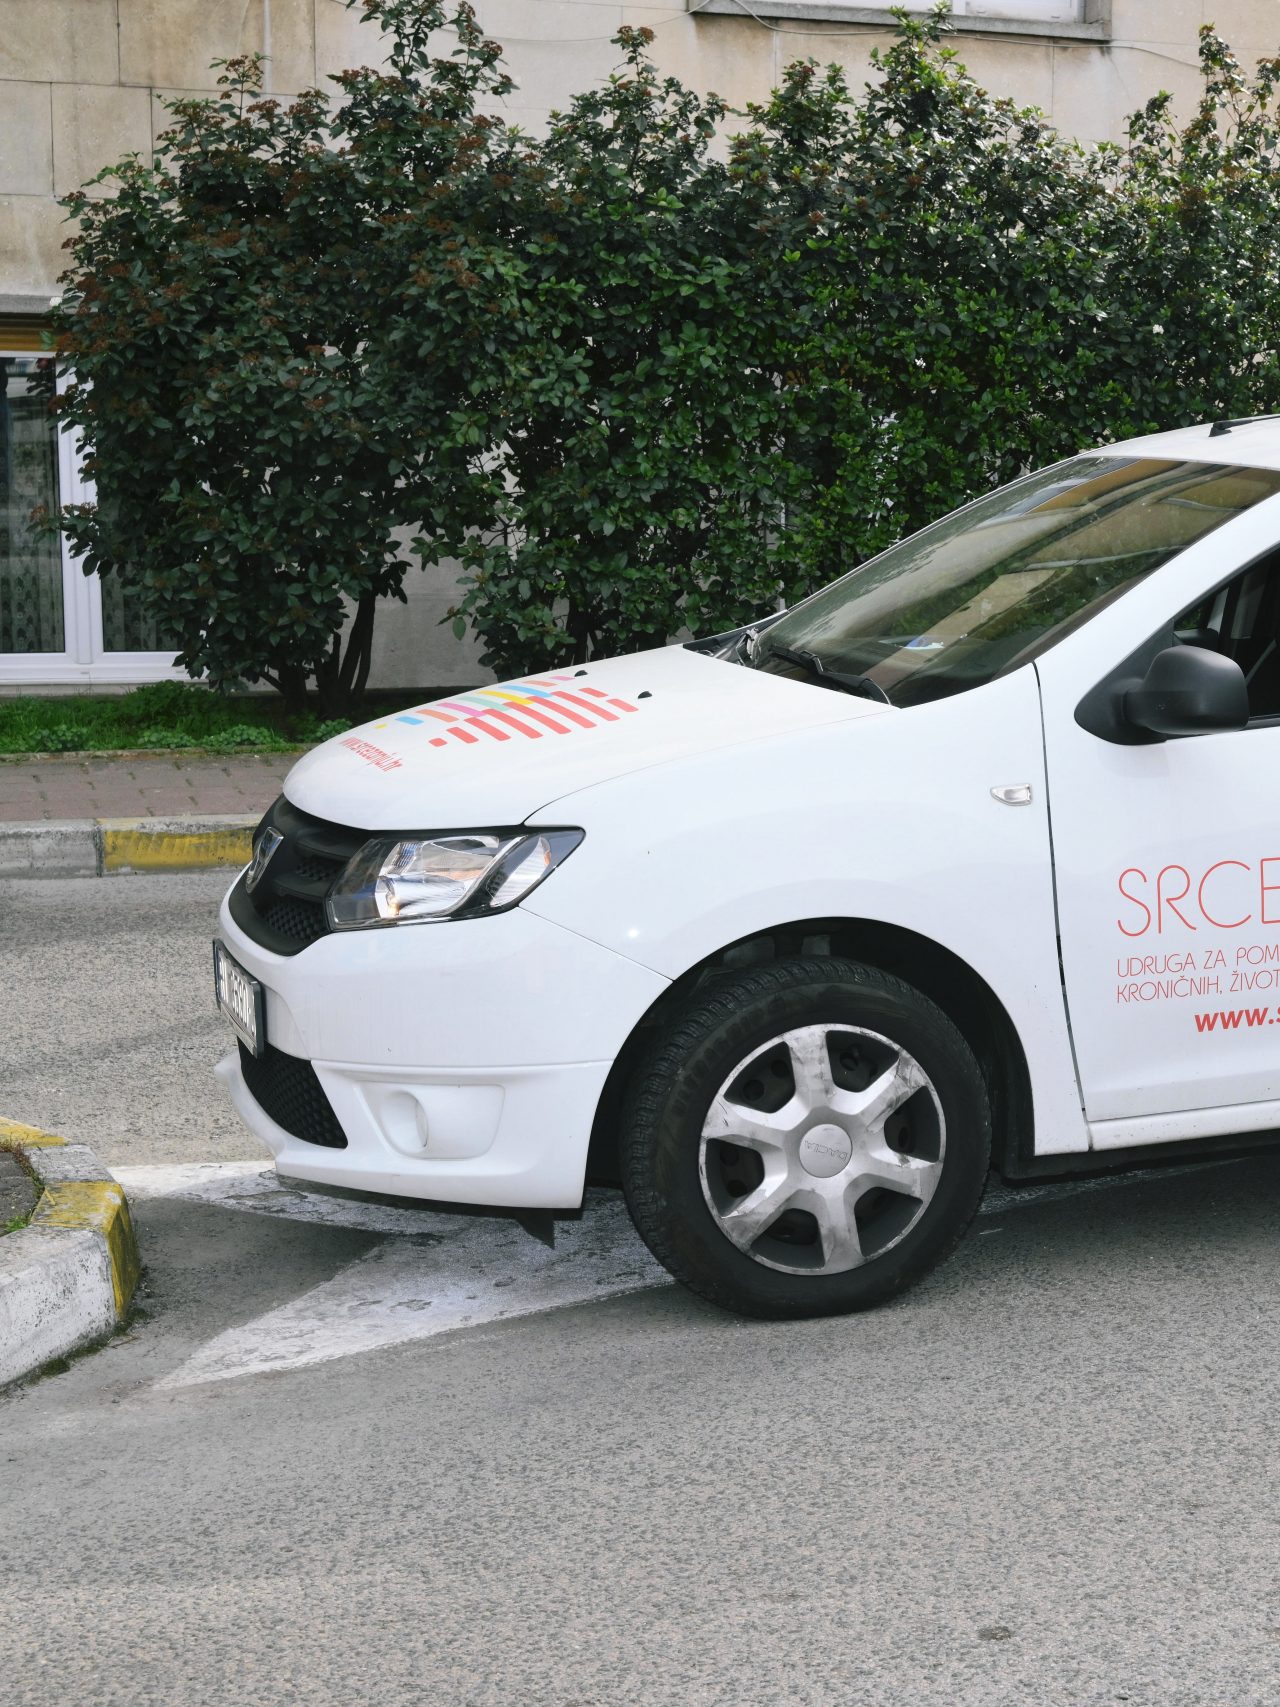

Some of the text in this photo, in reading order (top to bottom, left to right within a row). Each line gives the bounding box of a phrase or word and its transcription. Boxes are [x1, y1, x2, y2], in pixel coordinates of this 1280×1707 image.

[1116, 951, 1197, 978] UDRUGA
[1203, 949, 1227, 970] ZA
[1116, 975, 1223, 1004] KRONIČNIH,
